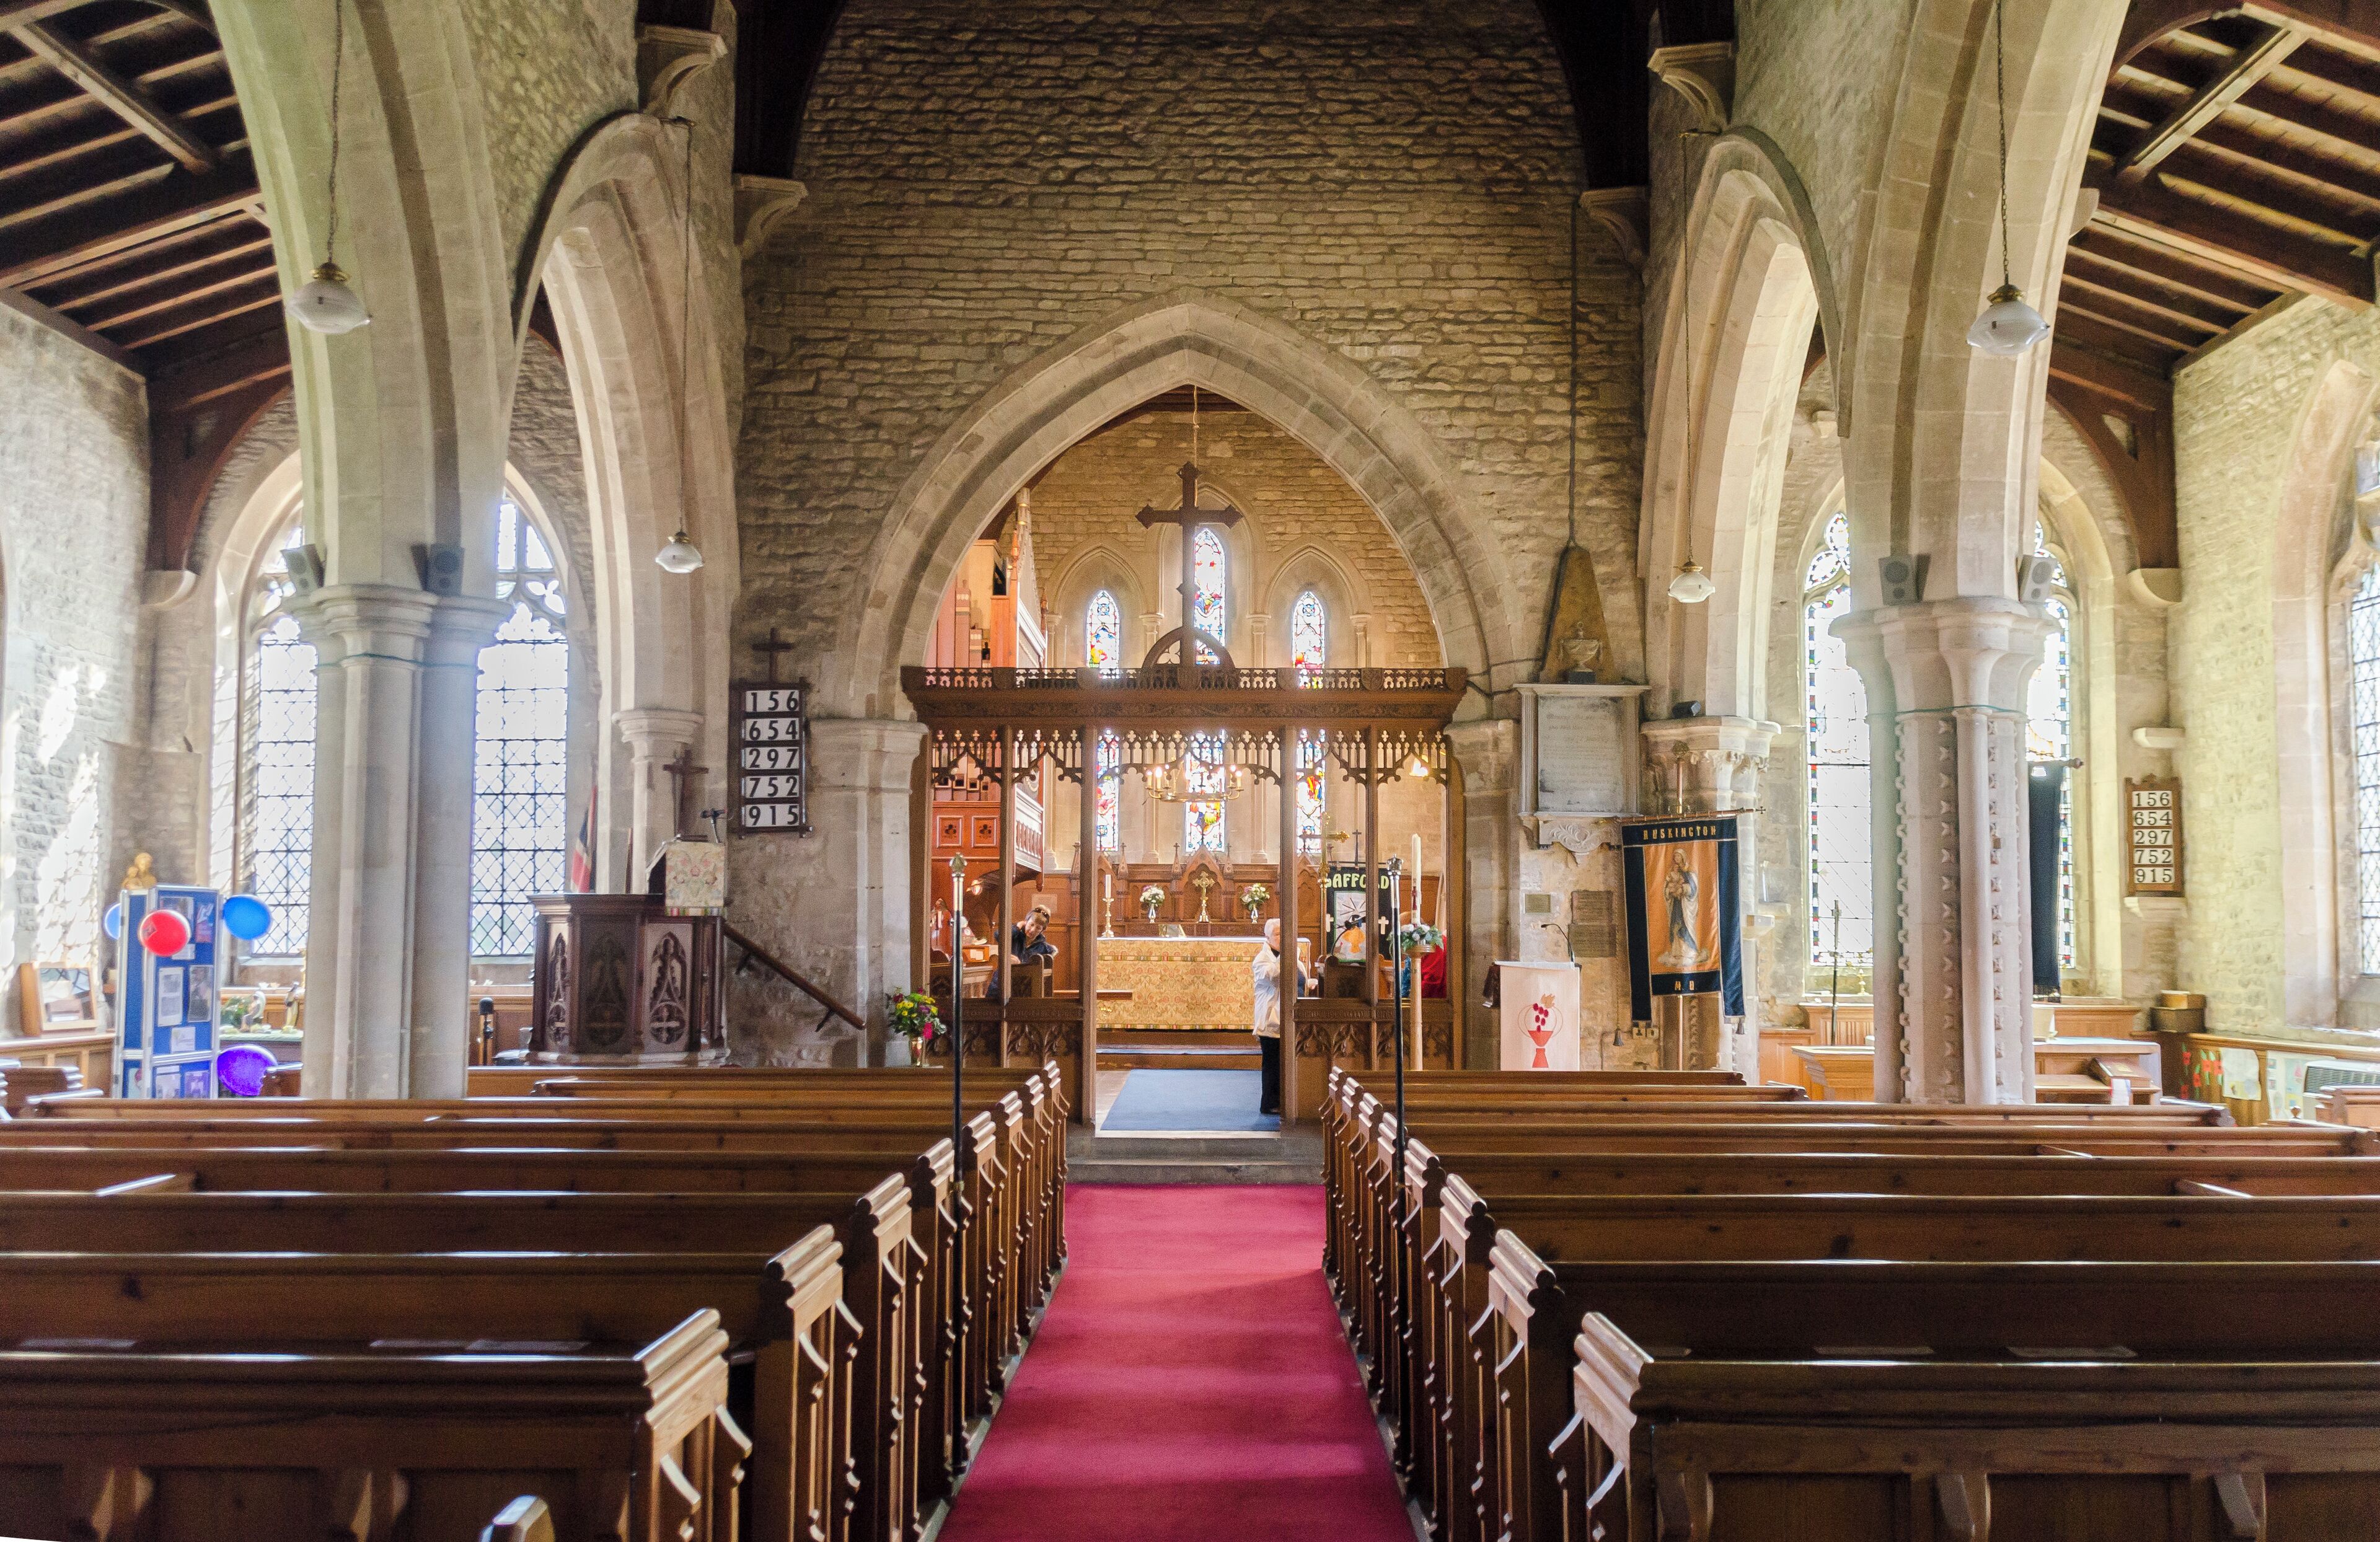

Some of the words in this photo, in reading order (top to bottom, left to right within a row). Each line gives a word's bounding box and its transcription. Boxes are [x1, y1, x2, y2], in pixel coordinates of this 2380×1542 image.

[750, 690, 799, 713] 156
[749, 720, 798, 741] 654
[749, 748, 798, 769] 297
[749, 777, 798, 797] 752
[2135, 792, 2171, 806] 156
[749, 805, 799, 826] 915
[2135, 811, 2172, 826] 654
[1643, 826, 1716, 840] RUSKINGTON
[2135, 830, 2172, 844] 297
[2135, 850, 2172, 864] 752
[1326, 873, 1390, 889] AFFOD
[2136, 868, 2172, 883] 915
